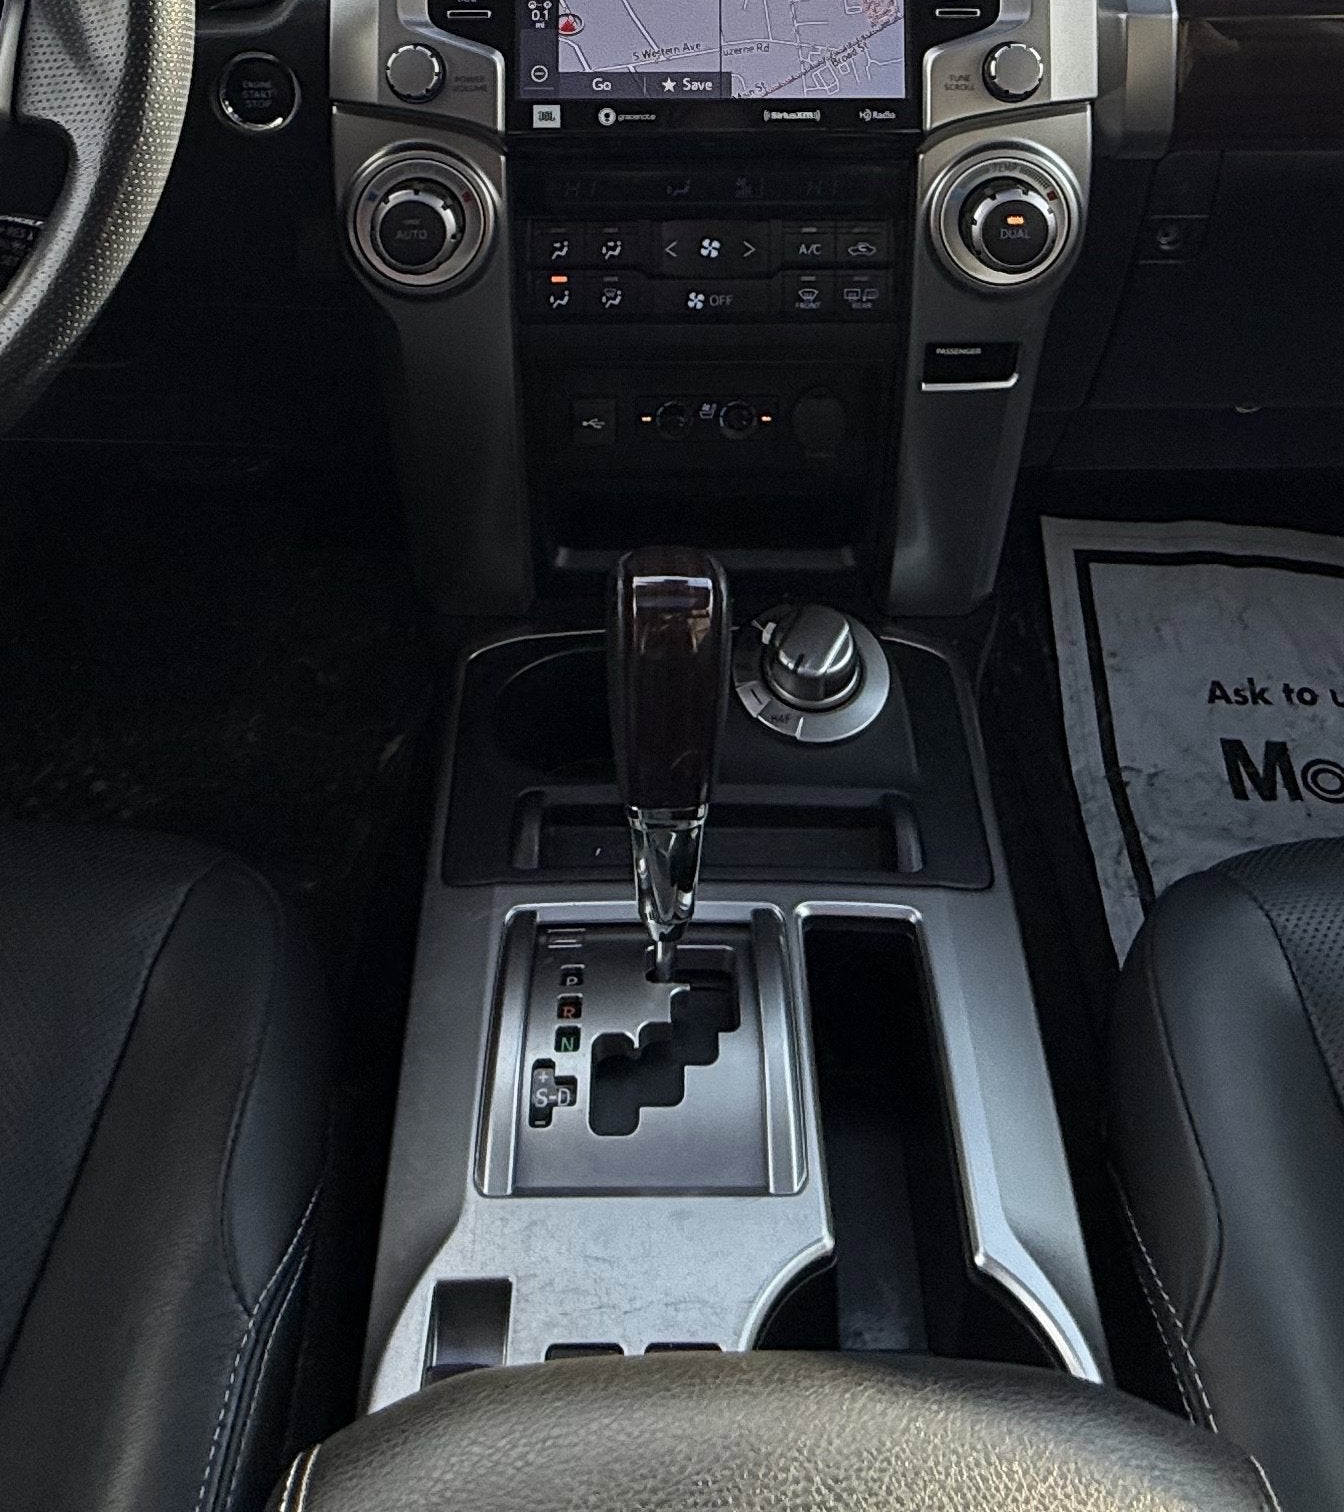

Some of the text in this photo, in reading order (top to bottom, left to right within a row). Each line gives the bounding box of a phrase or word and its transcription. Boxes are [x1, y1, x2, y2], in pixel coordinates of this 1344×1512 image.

[531, 9, 549, 21] 0.1
[632, 42, 701, 61] S Western Ave
[756, 42, 771, 53] Rd
[592, 78, 713, 91] Go Save
[394, 228, 429, 239] AUTO
[999, 228, 1031, 240] DUAL
[798, 243, 823, 256] A/C
[709, 294, 734, 306] OFF
[1207, 677, 1274, 706] Ask
[1282, 682, 1320, 706] to
[566, 975, 578, 986] P
[562, 1005, 575, 1018] R
[560, 1037, 574, 1052] N
